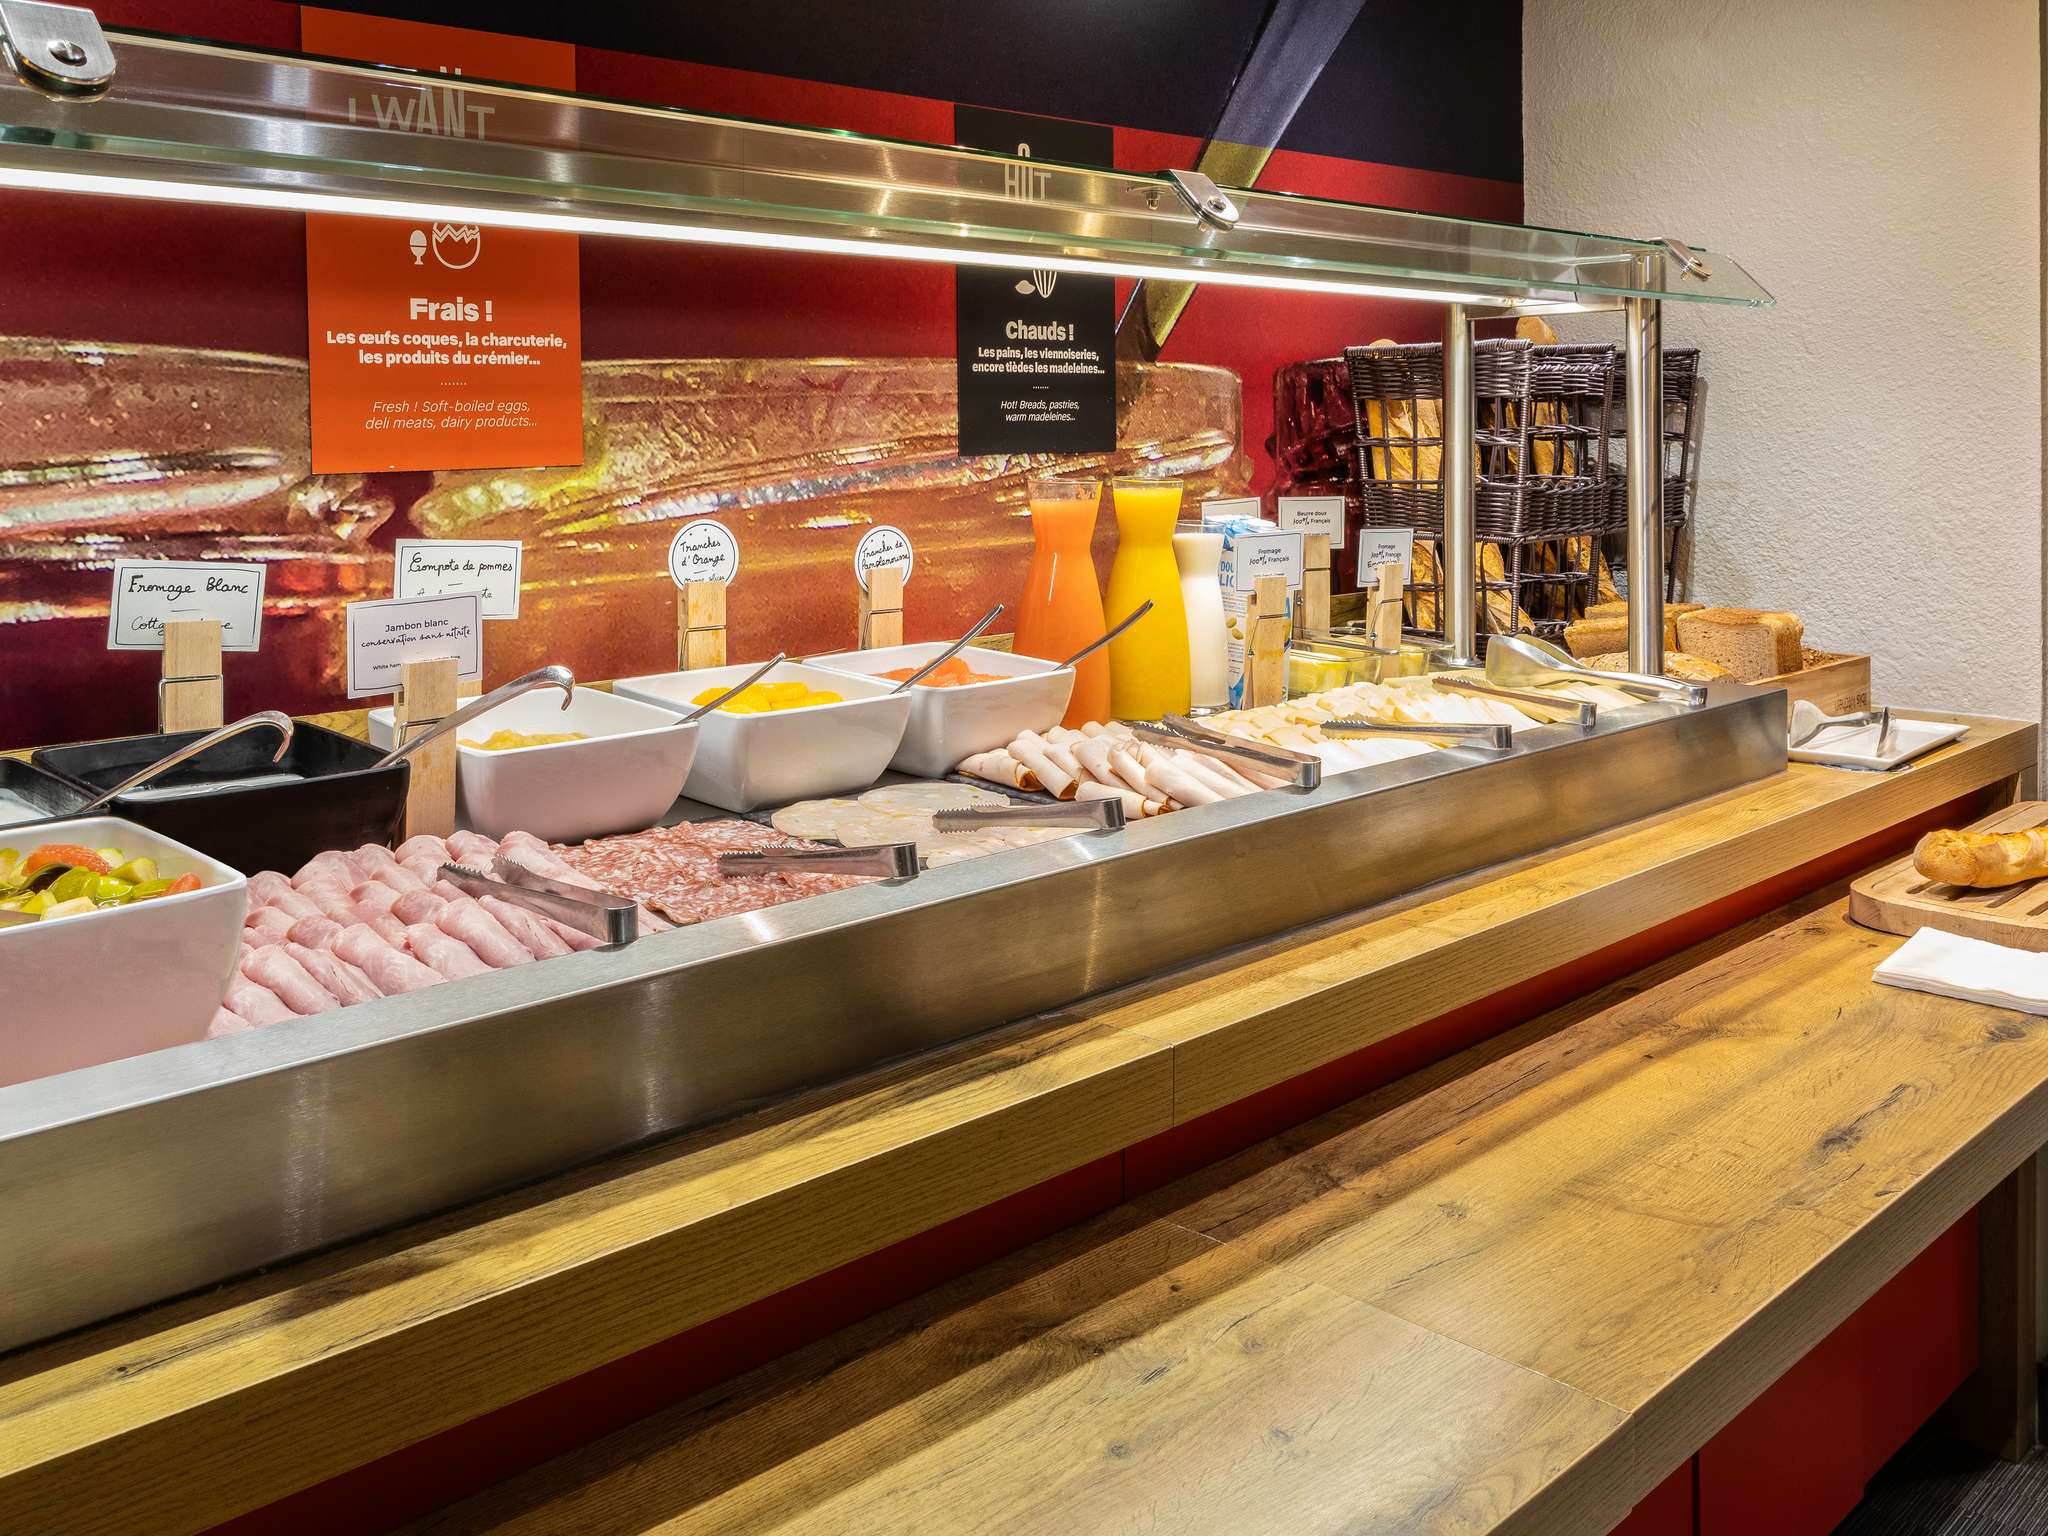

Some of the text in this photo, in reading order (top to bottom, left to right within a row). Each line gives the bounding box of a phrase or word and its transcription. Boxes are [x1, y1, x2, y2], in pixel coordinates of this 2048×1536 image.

[371, 83, 495, 142] WANT
[410, 297, 479, 322] Frais
[1005, 320, 1066, 341] Chauds
[327, 331, 567, 350] Les œufs coques, la charcuterie,
[359, 350, 541, 367] les produits du crémier...
[978, 347, 1099, 361] Les pains, les viennoiseries,
[972, 363, 1004, 373] encore
[1005, 361, 1034, 373] tièdes
[1035, 362, 1049, 373] les
[372, 400, 409, 413] Fresh
[422, 400, 493, 412] Soft-boiled
[497, 401, 530, 415] eggs,
[1000, 400, 1080, 411] Hot! Breads, pastries,
[365, 417, 390, 429] deli
[393, 417, 437, 430] meats,
[440, 416, 472, 430] dairy
[1006, 413, 1027, 422] warm
[680, 536, 721, 552] Tranches
[863, 540, 904, 558] Tranches de
[408, 552, 513, 577] Compote de pommes
[128, 574, 249, 601] Fromage Blanc
[385, 618, 449, 633] Jambon blanc
[361, 625, 472, 648] conservation sans nitrite
